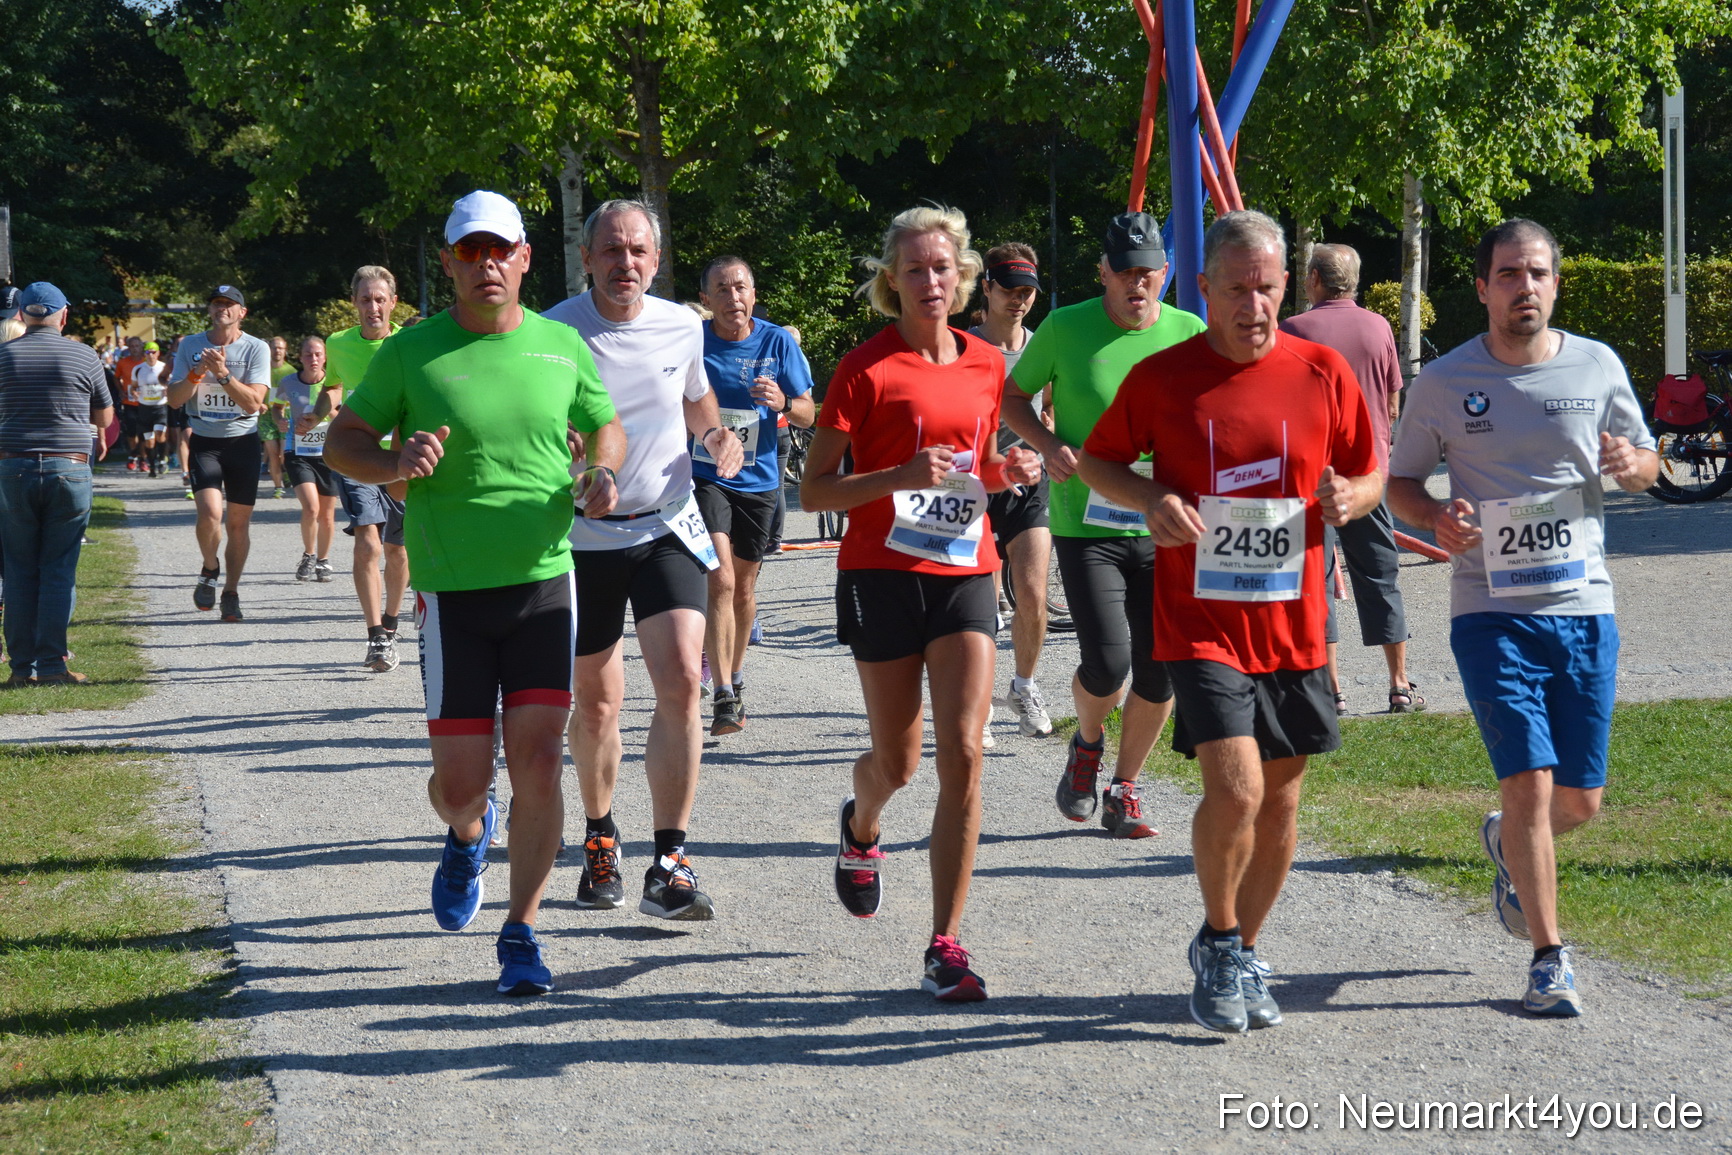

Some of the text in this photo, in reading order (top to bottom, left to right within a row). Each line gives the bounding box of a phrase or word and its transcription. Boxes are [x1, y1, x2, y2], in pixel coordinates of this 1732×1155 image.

[204, 394, 236, 408] 3118
[1544, 399, 1596, 411] BOCK
[1465, 420, 1493, 429] PARTL
[301, 431, 326, 443] 2239
[1234, 468, 1263, 483] DEHN
[909, 493, 976, 525] 2435
[1231, 506, 1277, 519] BOCK
[1510, 502, 1555, 517] BOCK
[1108, 510, 1140, 523] Helmut
[678, 513, 706, 539] 25
[915, 521, 959, 535] PARTL Neumarkt
[1213, 525, 1290, 558] 2436
[1498, 518, 1572, 555] 2496
[923, 538, 950, 552] Julia
[1219, 561, 1242, 569] PARTL
[1508, 555, 1561, 566] PARTL Neumarkt
[1234, 576, 1268, 589] Peter
[1510, 566, 1569, 585] Christoph
